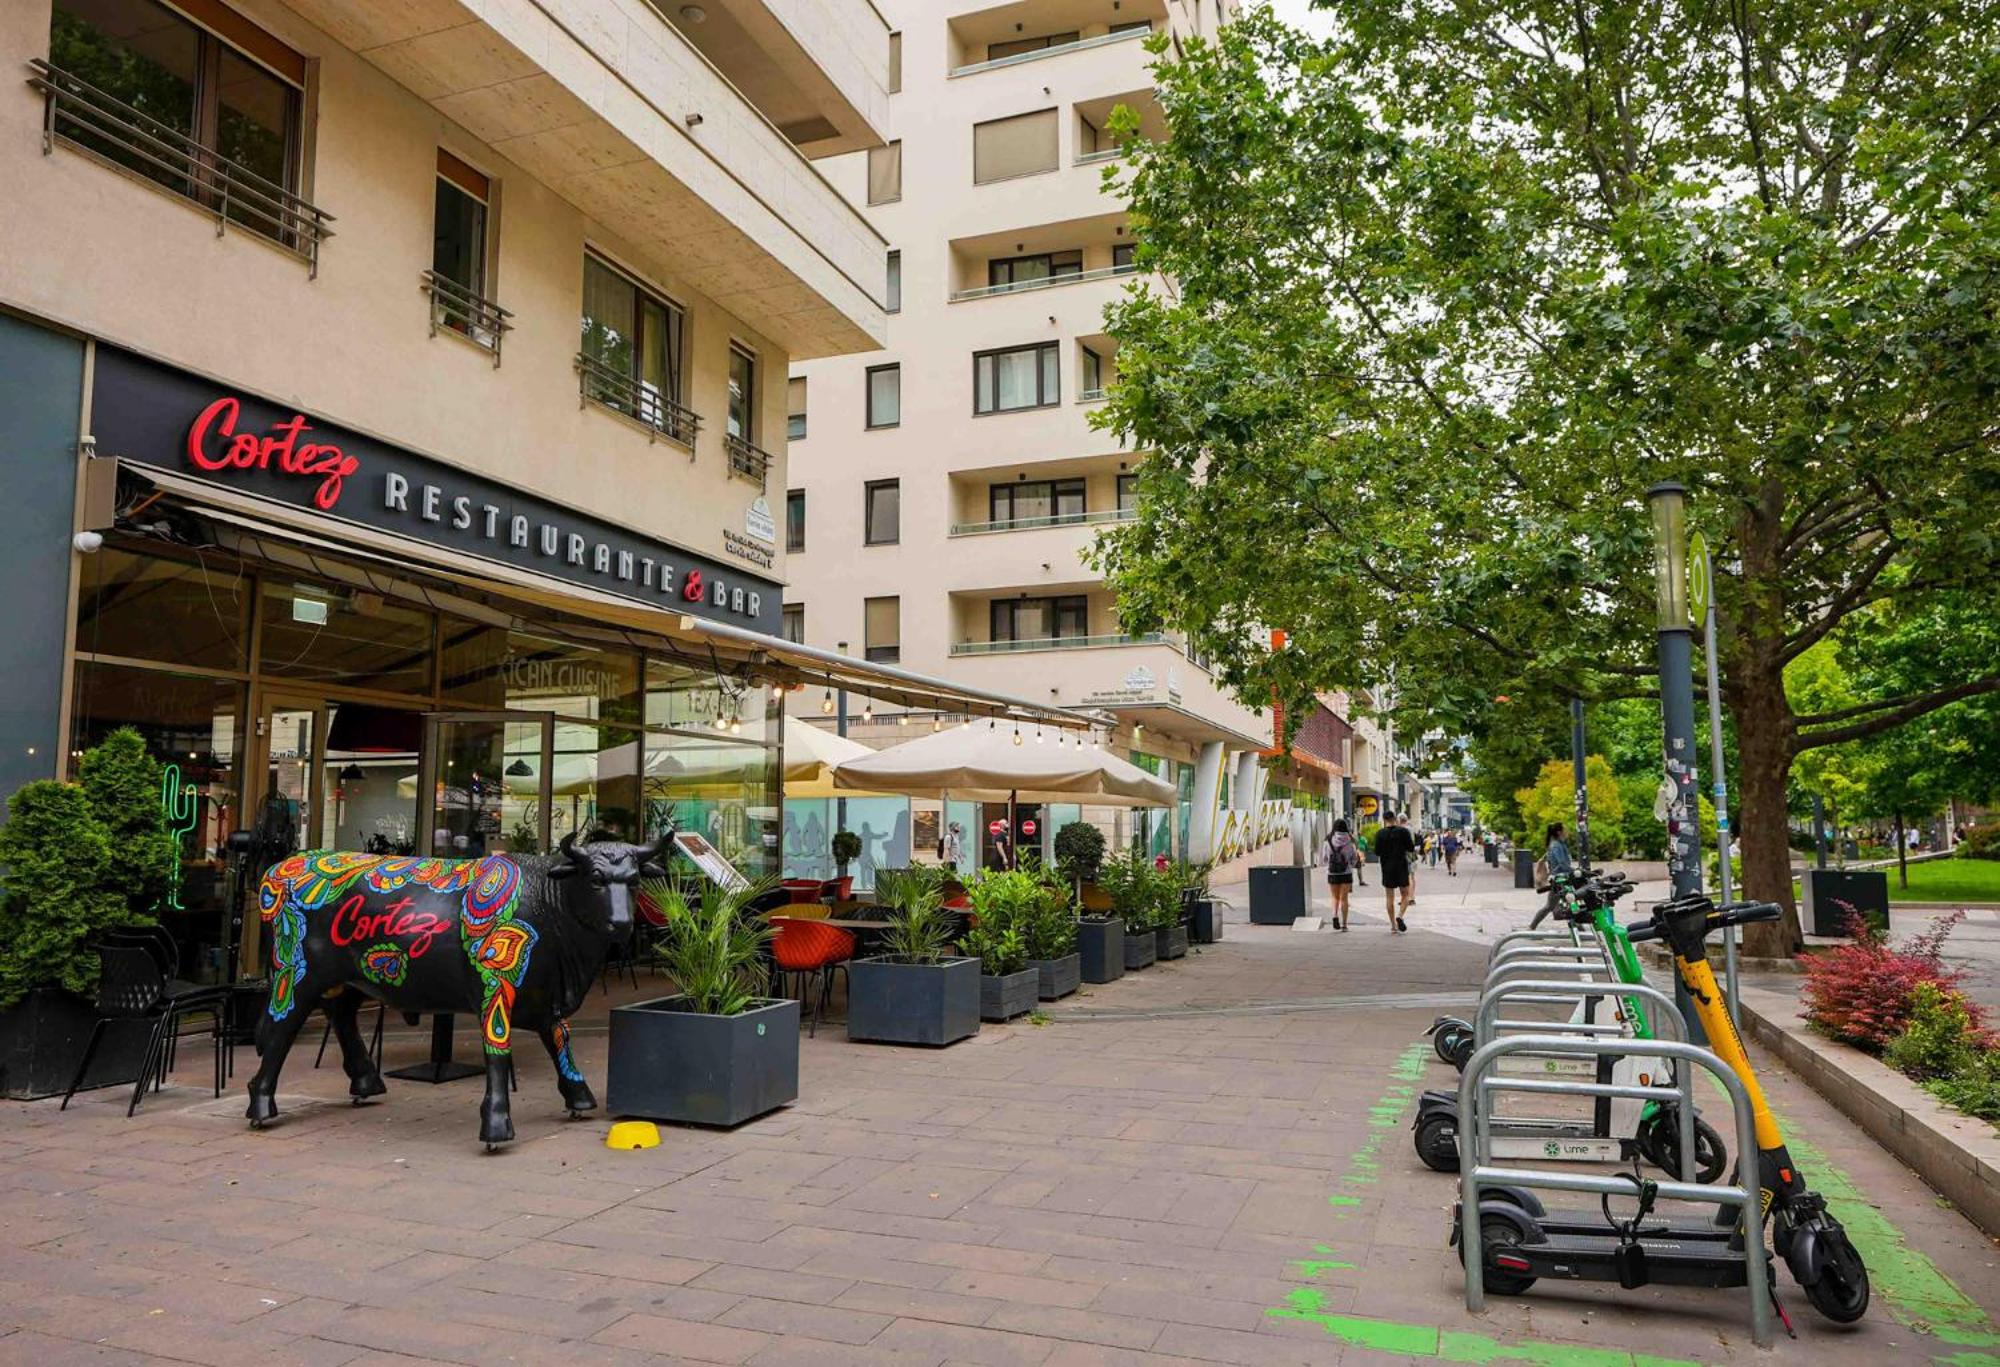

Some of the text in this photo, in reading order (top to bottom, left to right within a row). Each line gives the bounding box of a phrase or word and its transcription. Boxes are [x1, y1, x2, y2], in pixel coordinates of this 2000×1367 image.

[188, 397, 360, 509] Cortez
[385, 472, 673, 592] RESTAURANTE
[684, 568, 704, 602] &
[713, 580, 761, 616] BAR
[557, 663, 620, 700] CUISINE
[331, 894, 451, 958] Cortez
[1624, 999, 1642, 1033] ime
[1563, 1144, 1589, 1154] Lime
